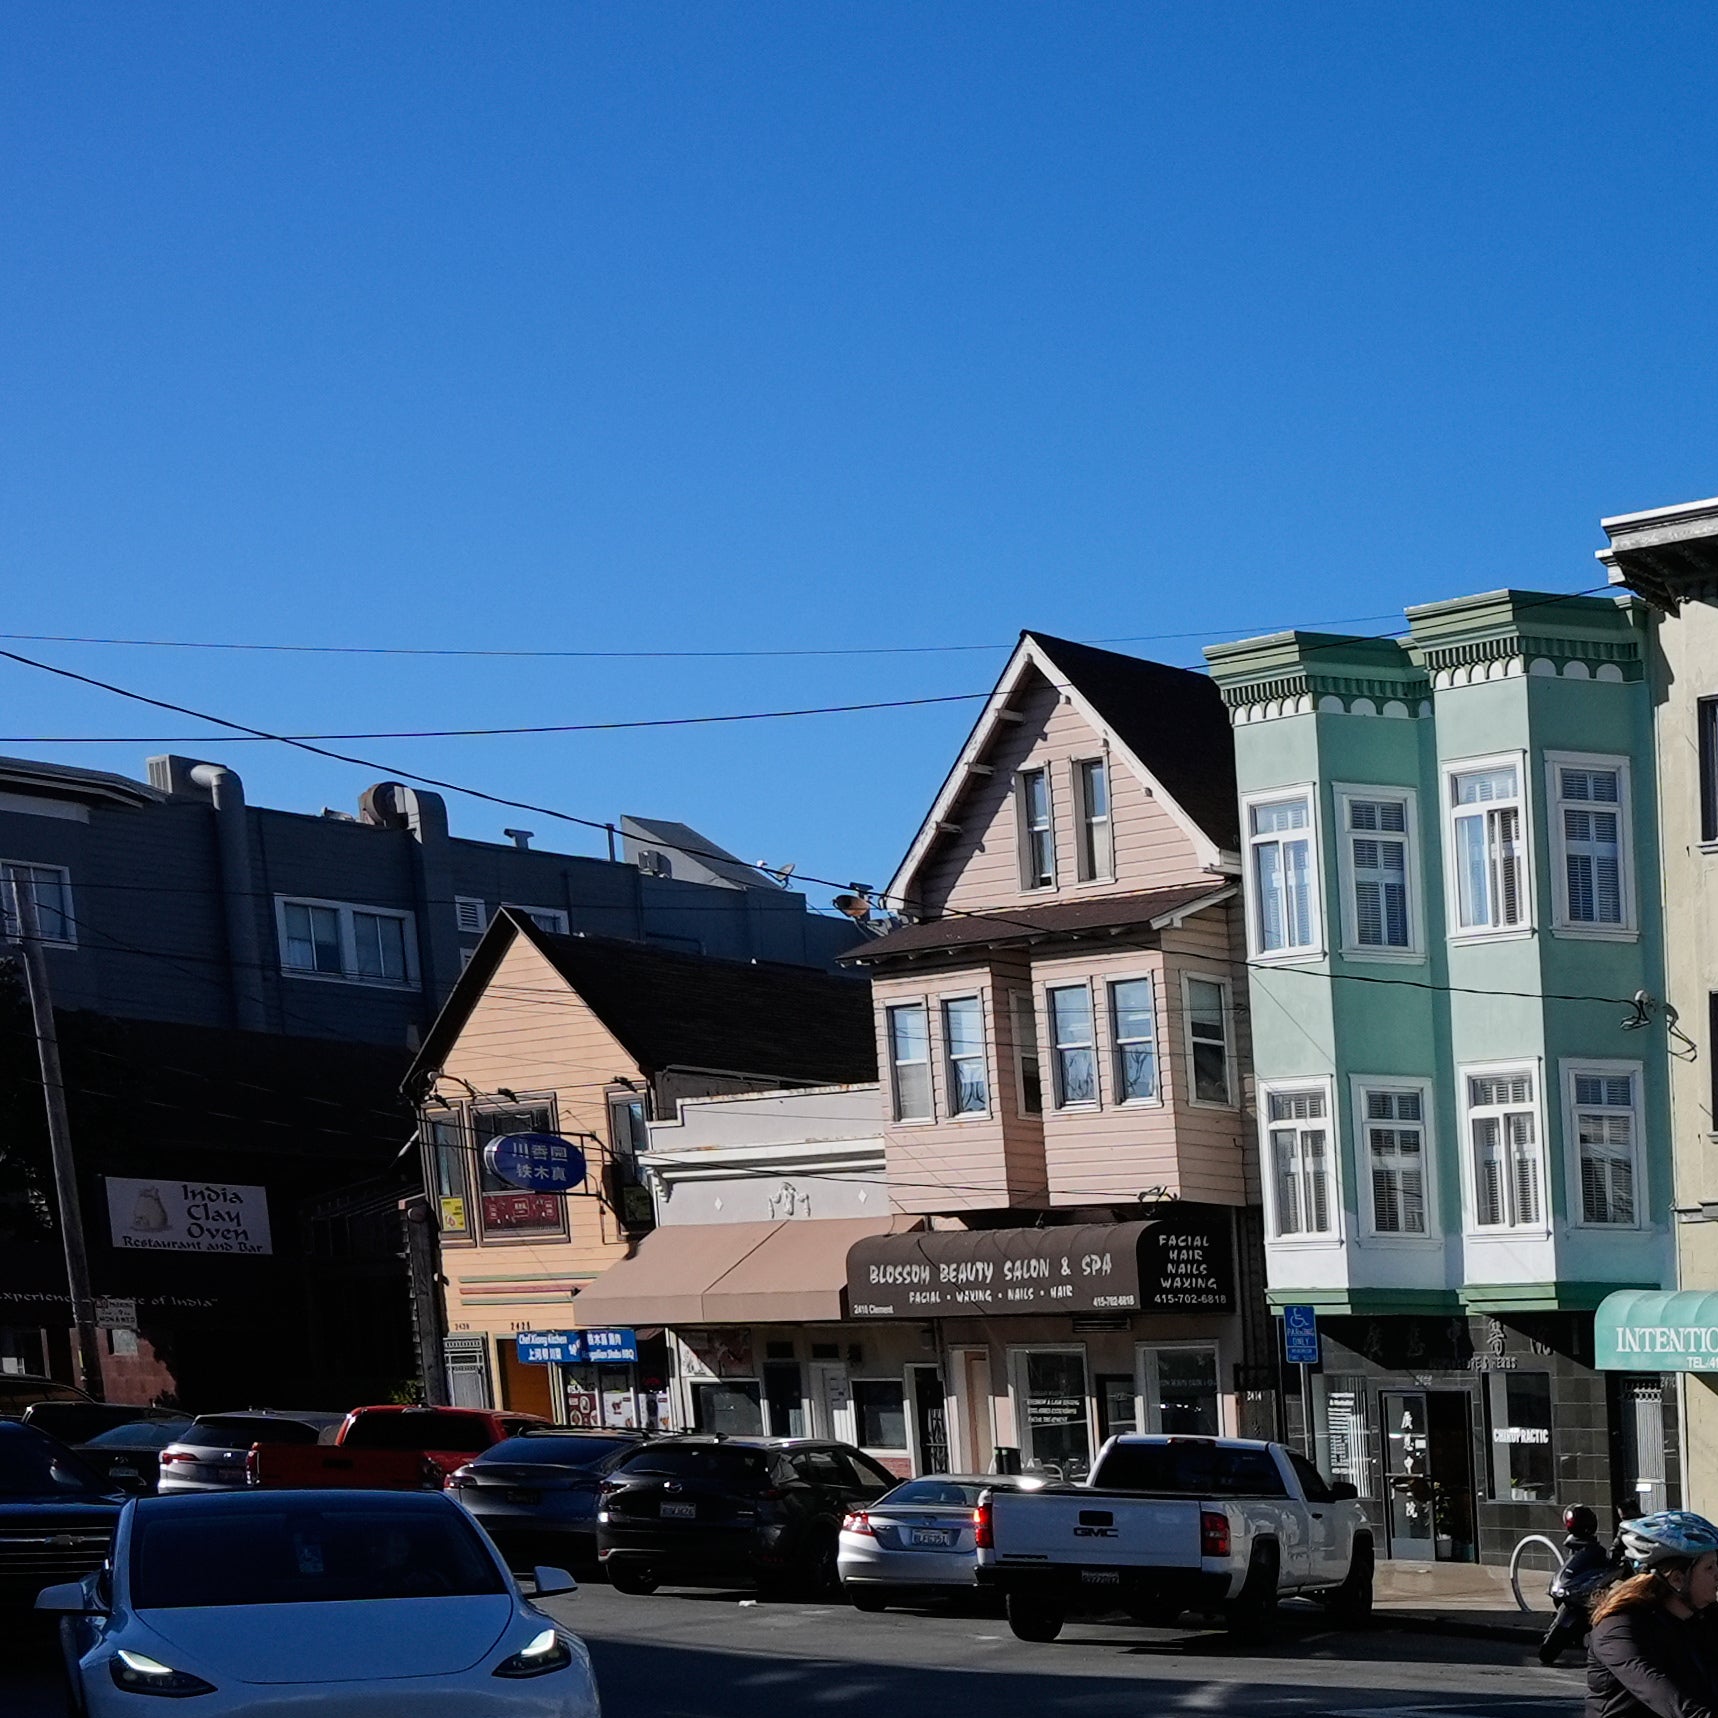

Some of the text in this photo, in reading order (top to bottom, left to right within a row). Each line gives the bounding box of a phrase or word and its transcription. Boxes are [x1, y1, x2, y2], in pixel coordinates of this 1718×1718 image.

[181, 1184, 244, 1204] India
[186, 1203, 242, 1227] Clay
[187, 1222, 249, 1241] Oven
[122, 1235, 263, 1253] Restaurant and Bar
[1158, 1234, 1210, 1247] FACIAL
[1169, 1249, 1203, 1261] HAIR
[868, 1252, 1112, 1284] BLOSSOM BEAUTY SALON & SPA
[1167, 1263, 1208, 1275] NAILS
[1160, 1276, 1217, 1290] WAXING
[908, 1284, 1073, 1304] FACIAL WAXING NAILS HAIR
[1154, 1293, 1227, 1304] 415-702-6818
[1073, 1528, 1119, 1538] GMC
